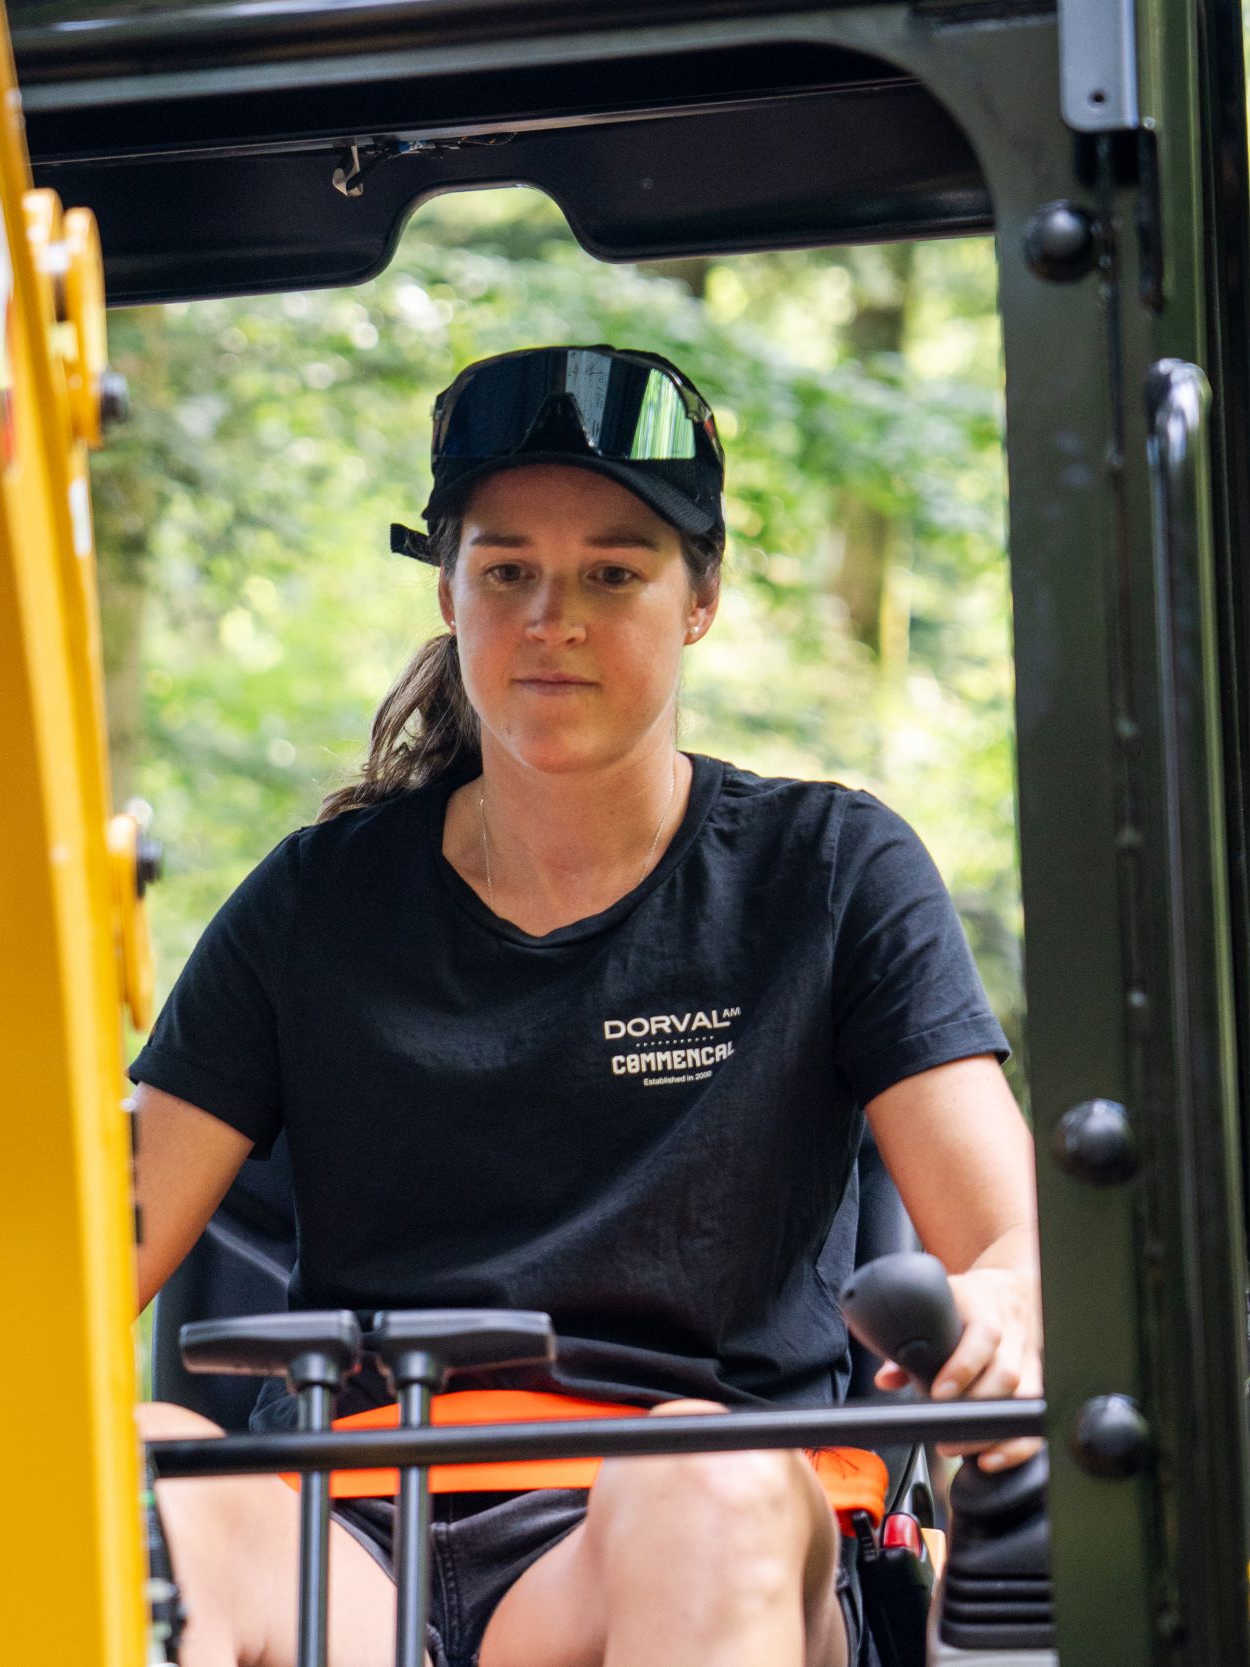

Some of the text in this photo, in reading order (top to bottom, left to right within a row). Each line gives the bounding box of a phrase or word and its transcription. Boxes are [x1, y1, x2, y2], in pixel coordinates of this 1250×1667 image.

[603, 1010, 731, 1040] DORVAL
[611, 1041, 735, 1075] COMMENCAL
[643, 1075, 686, 1087] Established
[686, 1074, 694, 1082] in
